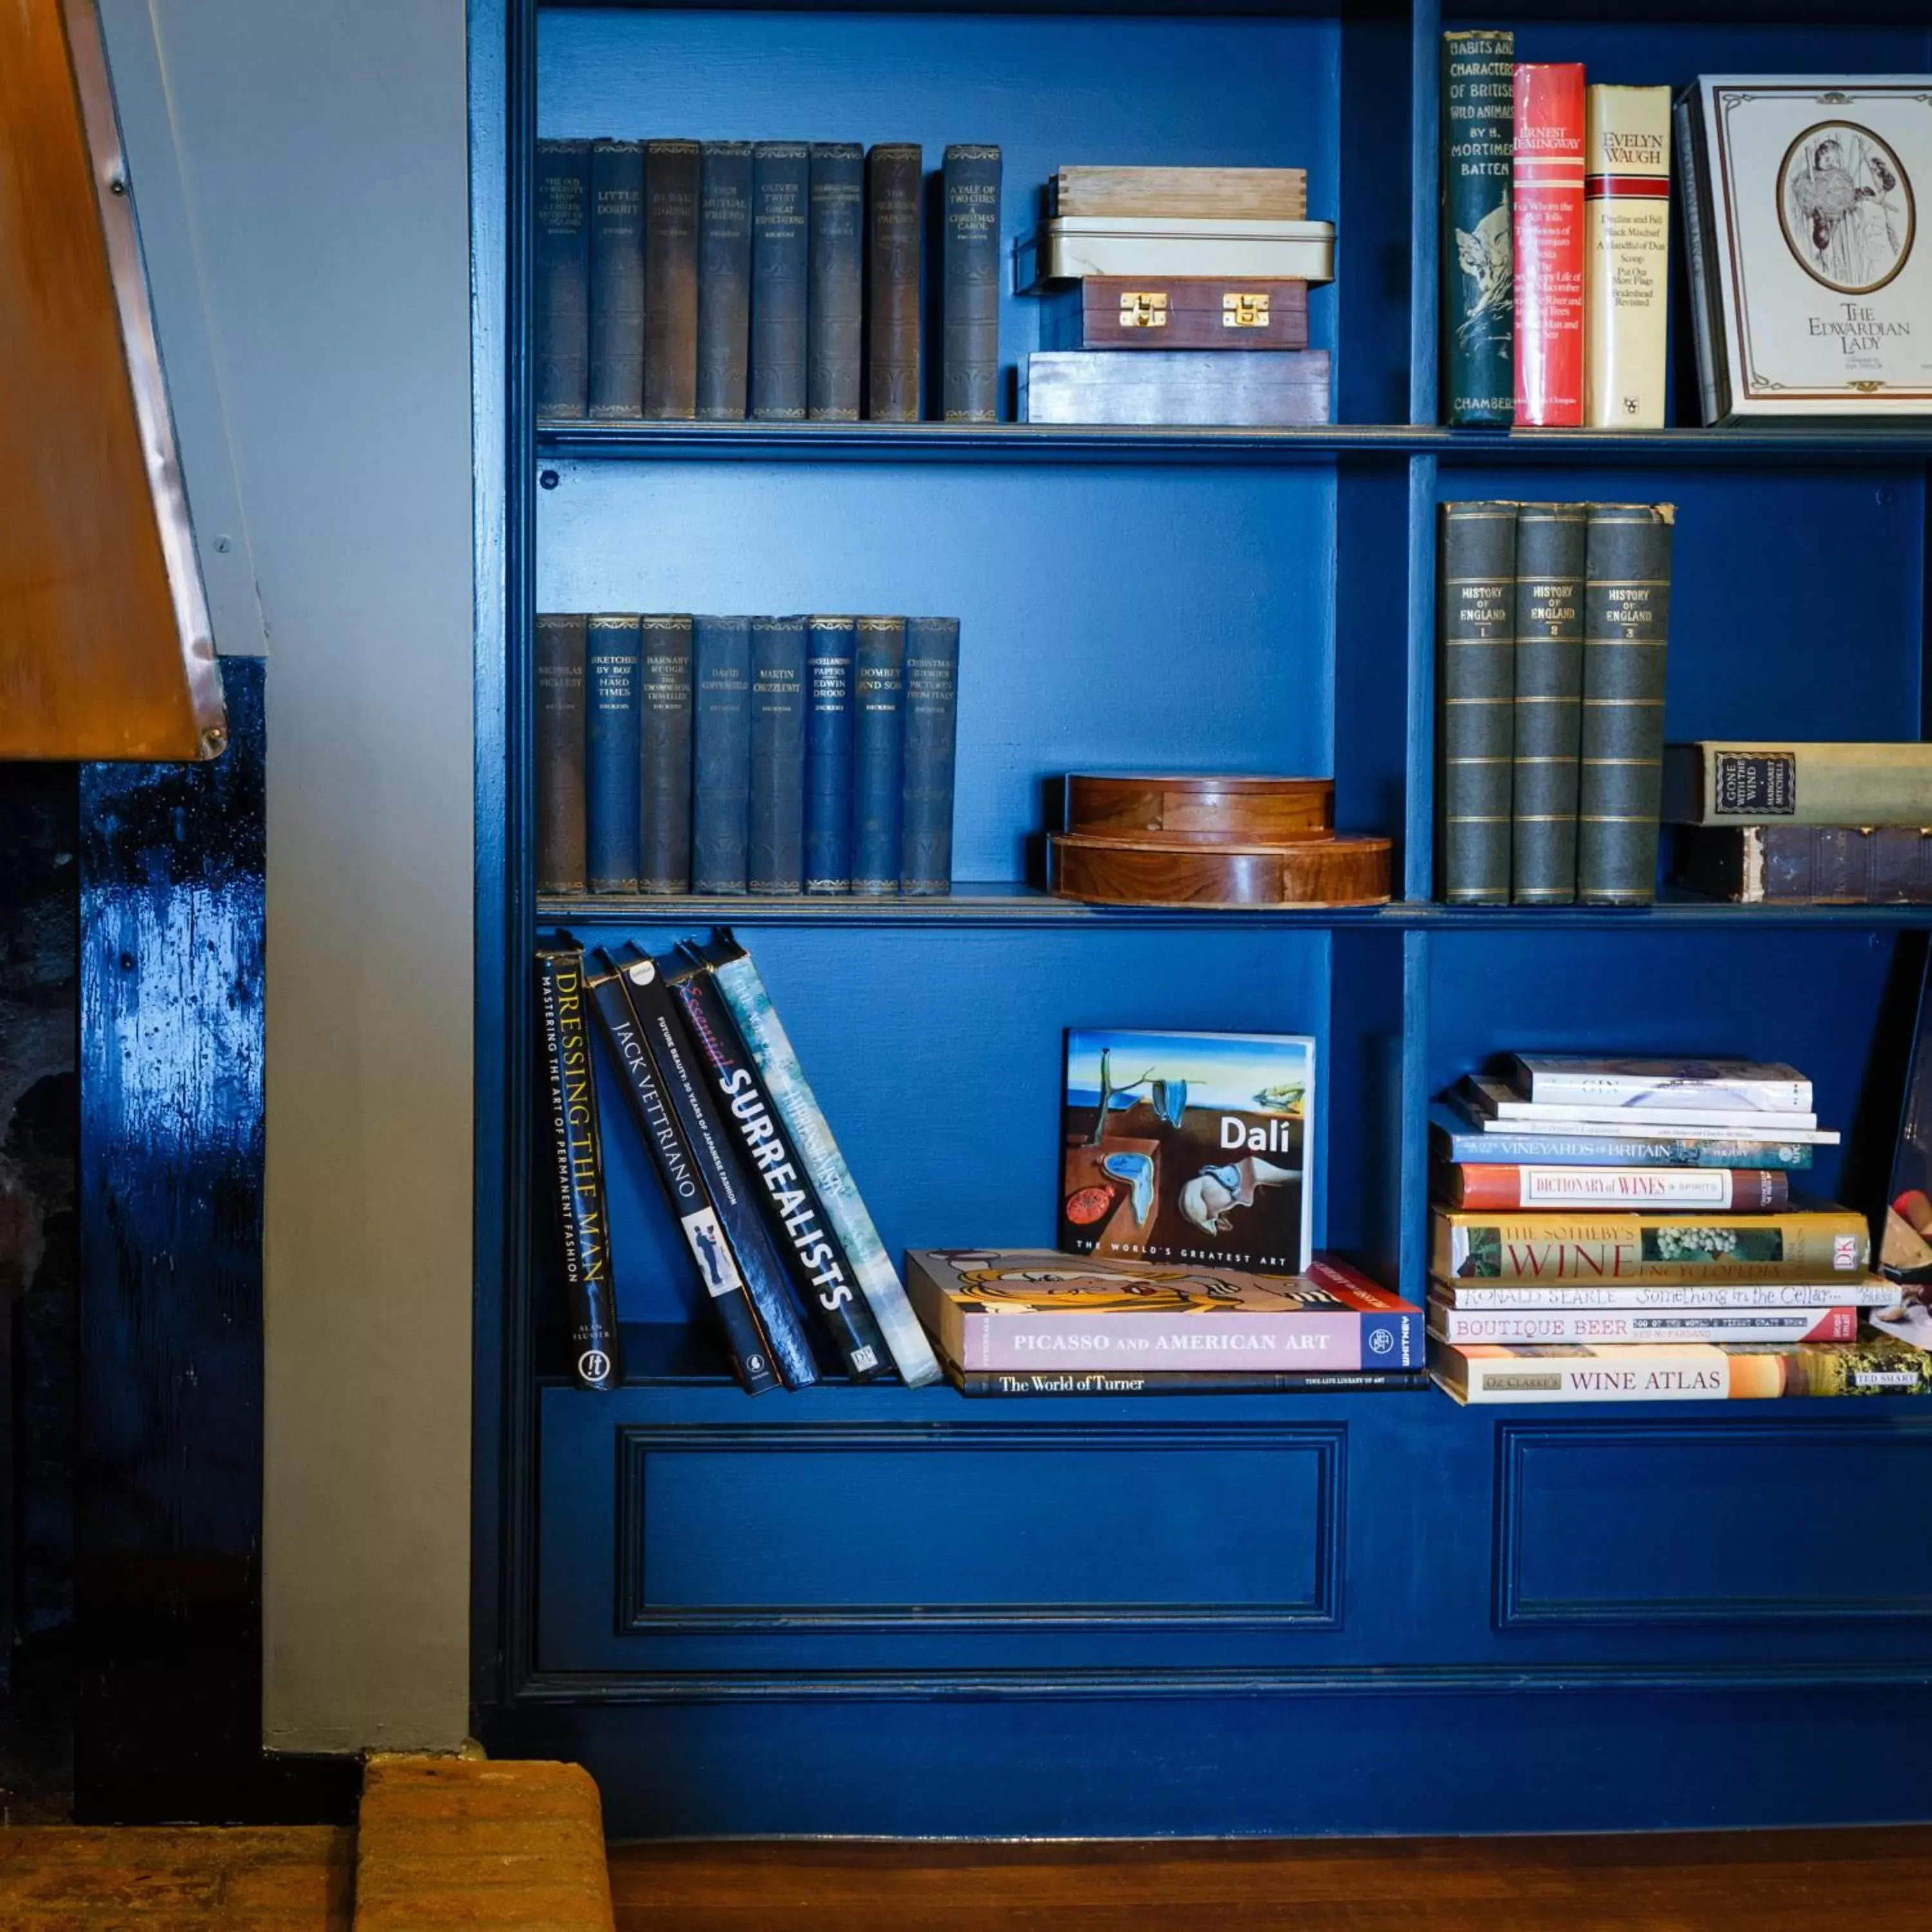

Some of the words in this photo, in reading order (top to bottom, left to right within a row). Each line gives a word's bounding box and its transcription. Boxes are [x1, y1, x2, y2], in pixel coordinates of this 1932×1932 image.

[1450, 41, 1492, 55] HABITS
[1450, 63, 1514, 77] CHARACTERS
[1450, 84, 1466, 98] OF
[1450, 106, 1475, 119] WILD
[1470, 128, 1486, 138] BY
[1489, 128, 1501, 138] H.
[1520, 127, 1567, 138] ERNEST
[1602, 132, 1663, 147] EVELYN
[1604, 147, 1660, 164] WAUGH
[1461, 163, 1509, 176] BATTEN
[598, 191, 639, 202] LITTLE
[958, 185, 979, 194] TALE
[982, 185, 996, 194] OF
[950, 195, 967, 204] TWO
[598, 205, 638, 216] DORRIT
[1596, 241, 1604, 250] A
[1840, 303, 1875, 321] THE
[1808, 317, 1911, 336] EDWARDIAN
[1841, 336, 1880, 355] LADY
[1463, 587, 1503, 598] HISTORY
[1533, 586, 1573, 597] HISTORY
[1608, 589, 1649, 601] HISTORY
[1477, 600, 1490, 608] OF
[1548, 599, 1561, 607] OF
[1622, 602, 1636, 611] OF
[1460, 610, 1506, 621] ENGLAND
[1531, 608, 1575, 620] ENGLAND
[1606, 610, 1652, 621] ENGLAND
[596, 667, 608, 675] BY
[612, 667, 631, 675] BOZ
[761, 670, 795, 679] MARTIN
[860, 668, 901, 677] DOMBEY
[599, 678, 629, 687] HARD
[859, 681, 882, 690] AND
[1737, 759, 1746, 780] THE
[1727, 764, 1737, 800] GONE
[1747, 766, 1757, 800] WIND
[542, 976, 558, 1052] MASTERING
[657, 1016, 674, 1048] FUTURE
[555, 971, 591, 1126] DRESSING
[549, 1058, 560, 1083] THE
[683, 1083, 692, 1092] 30
[551, 1088, 562, 1112] ART
[687, 1090, 703, 1120] YEARS
[611, 1021, 647, 1074] JACK
[638, 1074, 696, 1198] VETTRIANO
[554, 1117, 565, 1135] OF
[698, 1119, 708, 1131] OF
[1220, 1115, 1289, 1153] Dalí
[703, 1131, 724, 1172] JAPANESE
[1501, 1142, 1595, 1155] VINEYARDS
[1608, 1143, 1671, 1158] BRITAIN
[571, 1133, 597, 1197] THE
[556, 1141, 573, 1218] PERMANENT
[1537, 1177, 1605, 1193] DICTIONARY
[1605, 1183, 1616, 1193] of
[1618, 1177, 1665, 1196] WINES
[1678, 1184, 1718, 1192] SPIRITS
[719, 1171, 737, 1206] FASHION
[719, 1068, 854, 1312] SURREALISTS
[1506, 1226, 1537, 1240] THE
[1544, 1226, 1635, 1240] SOTHEBY'S
[564, 1224, 578, 1283] FASHION
[578, 1211, 604, 1282] MAN
[1077, 1240, 1101, 1250] THE
[1111, 1243, 1172, 1255] WORLD'S
[1180, 1249, 1251, 1263] GREATEST
[1260, 1255, 1286, 1266] ART
[1835, 1236, 1855, 1269] DK
[1507, 1244, 1634, 1278] WINE
[1640, 1264, 1781, 1278] ENCYCLOPEDIA
[1465, 1289, 1540, 1305] RONALD
[1549, 1289, 1618, 1305] SEARLE
[1636, 1288, 1727, 1305] Something
[1732, 1289, 1750, 1302] in
[1752, 1286, 1774, 1303] the
[1457, 1320, 1564, 1338] BOUTIQUE
[1575, 1320, 1628, 1335] BEER
[1012, 1335, 1110, 1350] PICASSO
[1116, 1338, 1149, 1350] AND
[1154, 1334, 1278, 1350] AMERICAN
[1283, 1334, 1331, 1350] ART
[1401, 1316, 1410, 1367] WHITNEY
[999, 1376, 1029, 1392] The
[1032, 1376, 1074, 1392] World
[1076, 1375, 1095, 1391] of
[1094, 1374, 1145, 1391] Turner
[1569, 1372, 1636, 1390] WINE
[1645, 1371, 1721, 1390] ATLAS
[1857, 1374, 1879, 1383] TED
[1880, 1374, 1915, 1383] SMART
